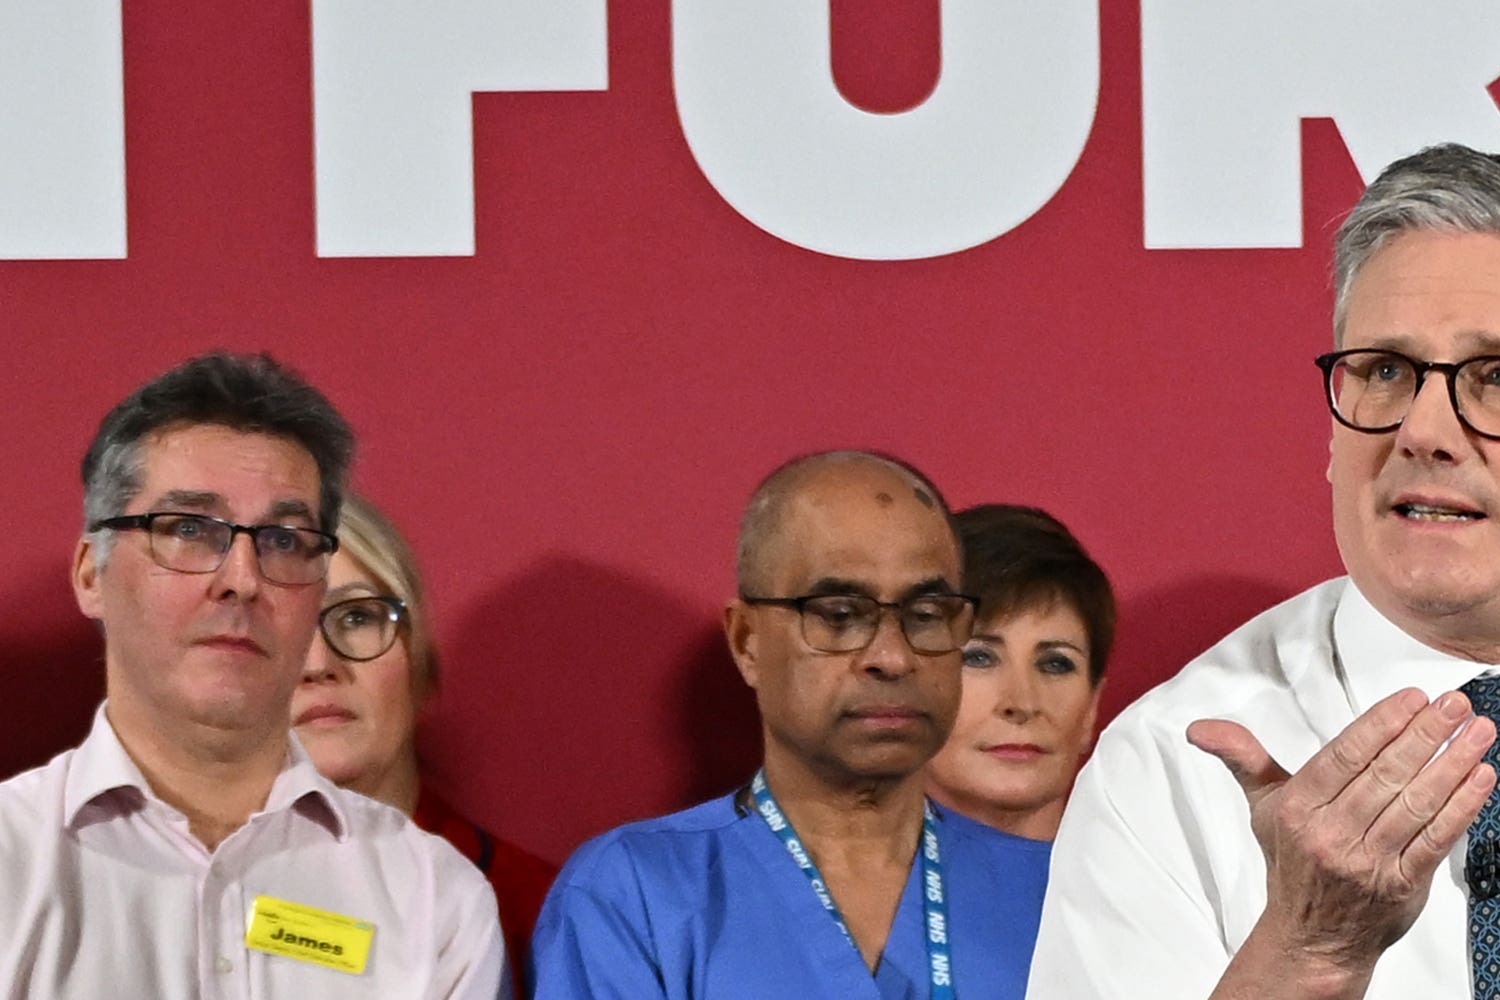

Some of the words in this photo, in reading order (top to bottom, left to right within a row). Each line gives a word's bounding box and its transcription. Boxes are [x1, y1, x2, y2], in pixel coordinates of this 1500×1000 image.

[926, 870, 943, 904] NHS
[269, 927, 345, 957] James
[928, 911, 947, 945] NHS
[931, 953, 951, 987] NHS
